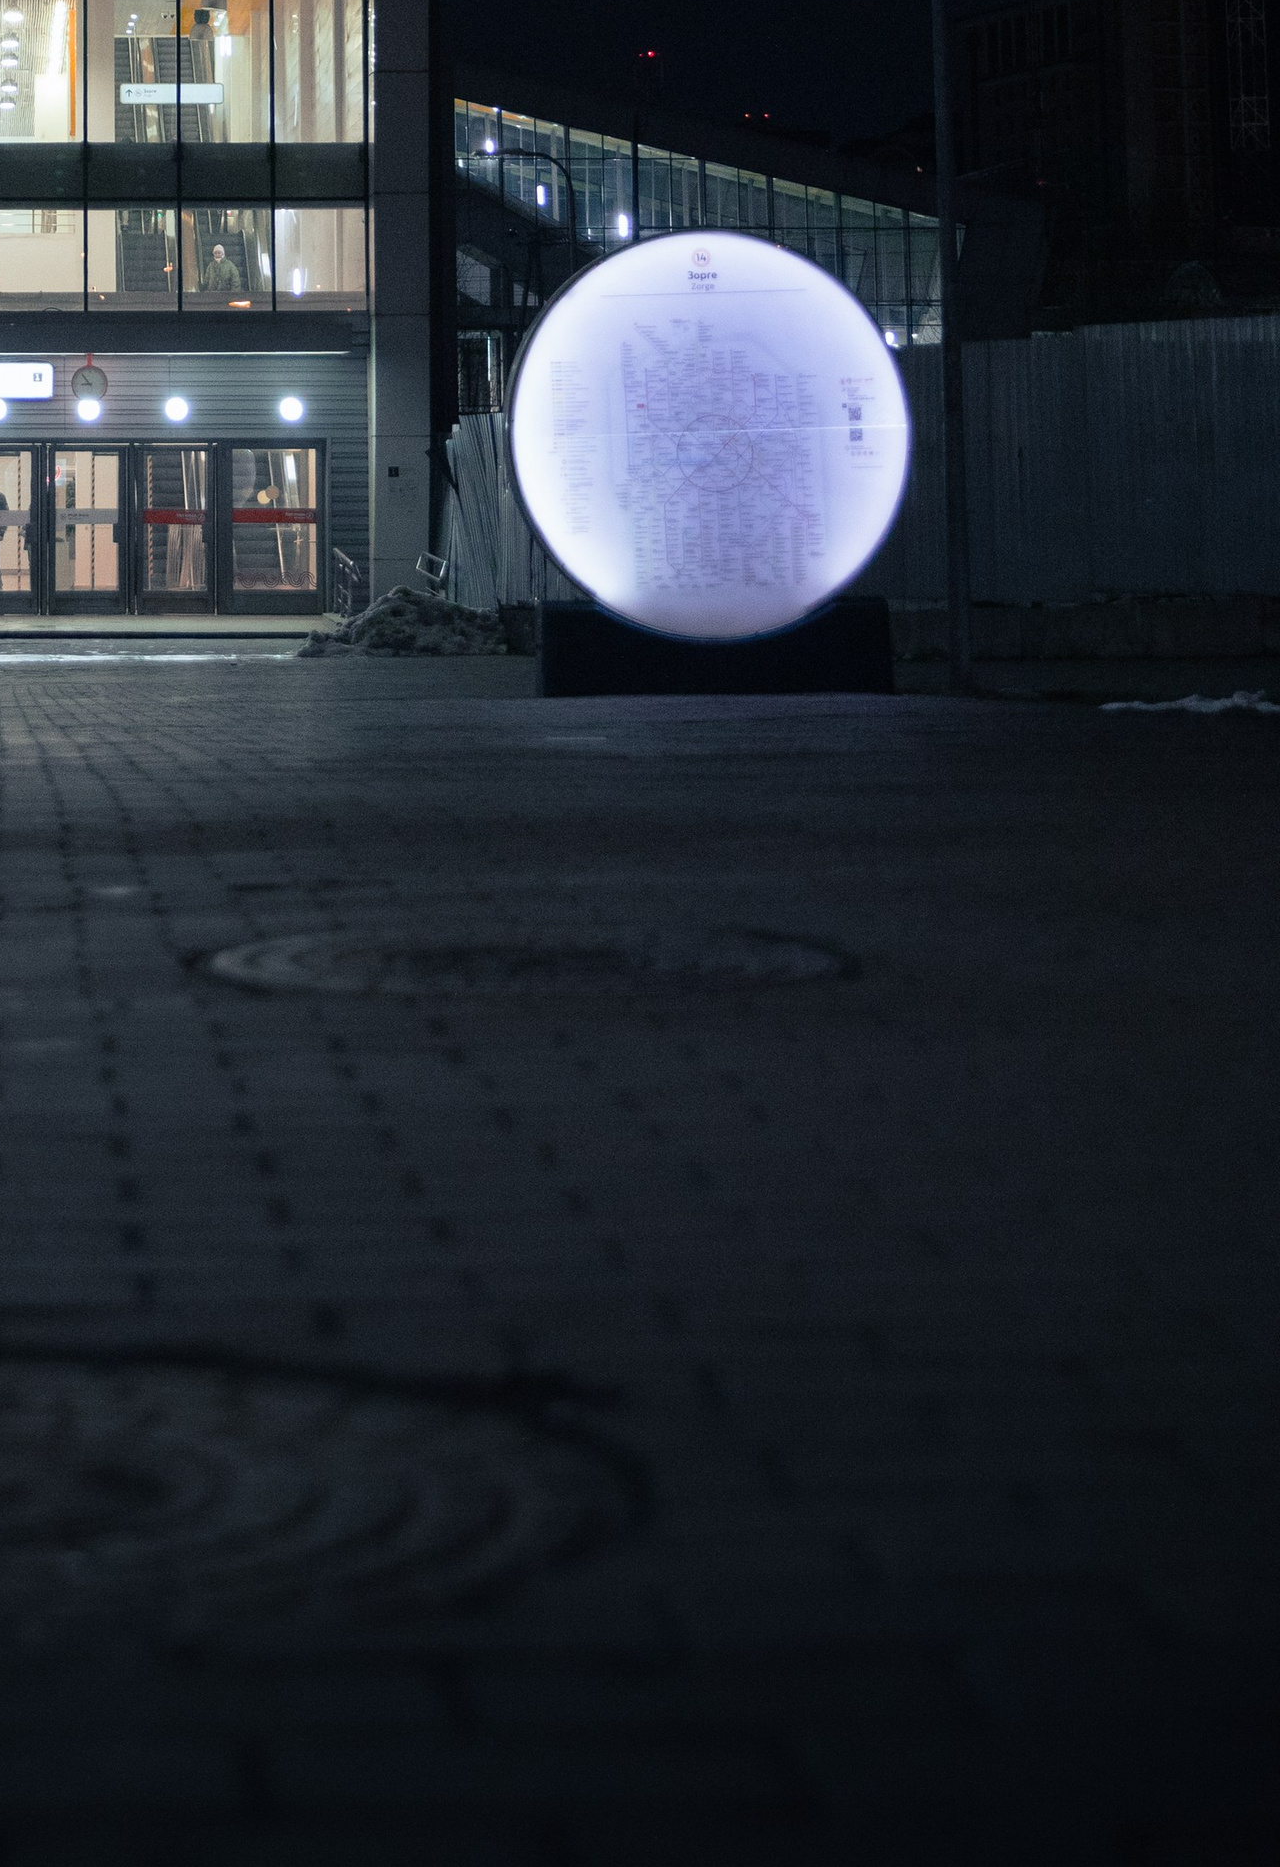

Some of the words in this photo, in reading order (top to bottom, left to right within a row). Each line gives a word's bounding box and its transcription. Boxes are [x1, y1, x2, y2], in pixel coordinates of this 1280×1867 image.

[696, 253, 707, 261] 14
[687, 271, 718, 281] Зорге
[691, 283, 715, 291] Zorge
